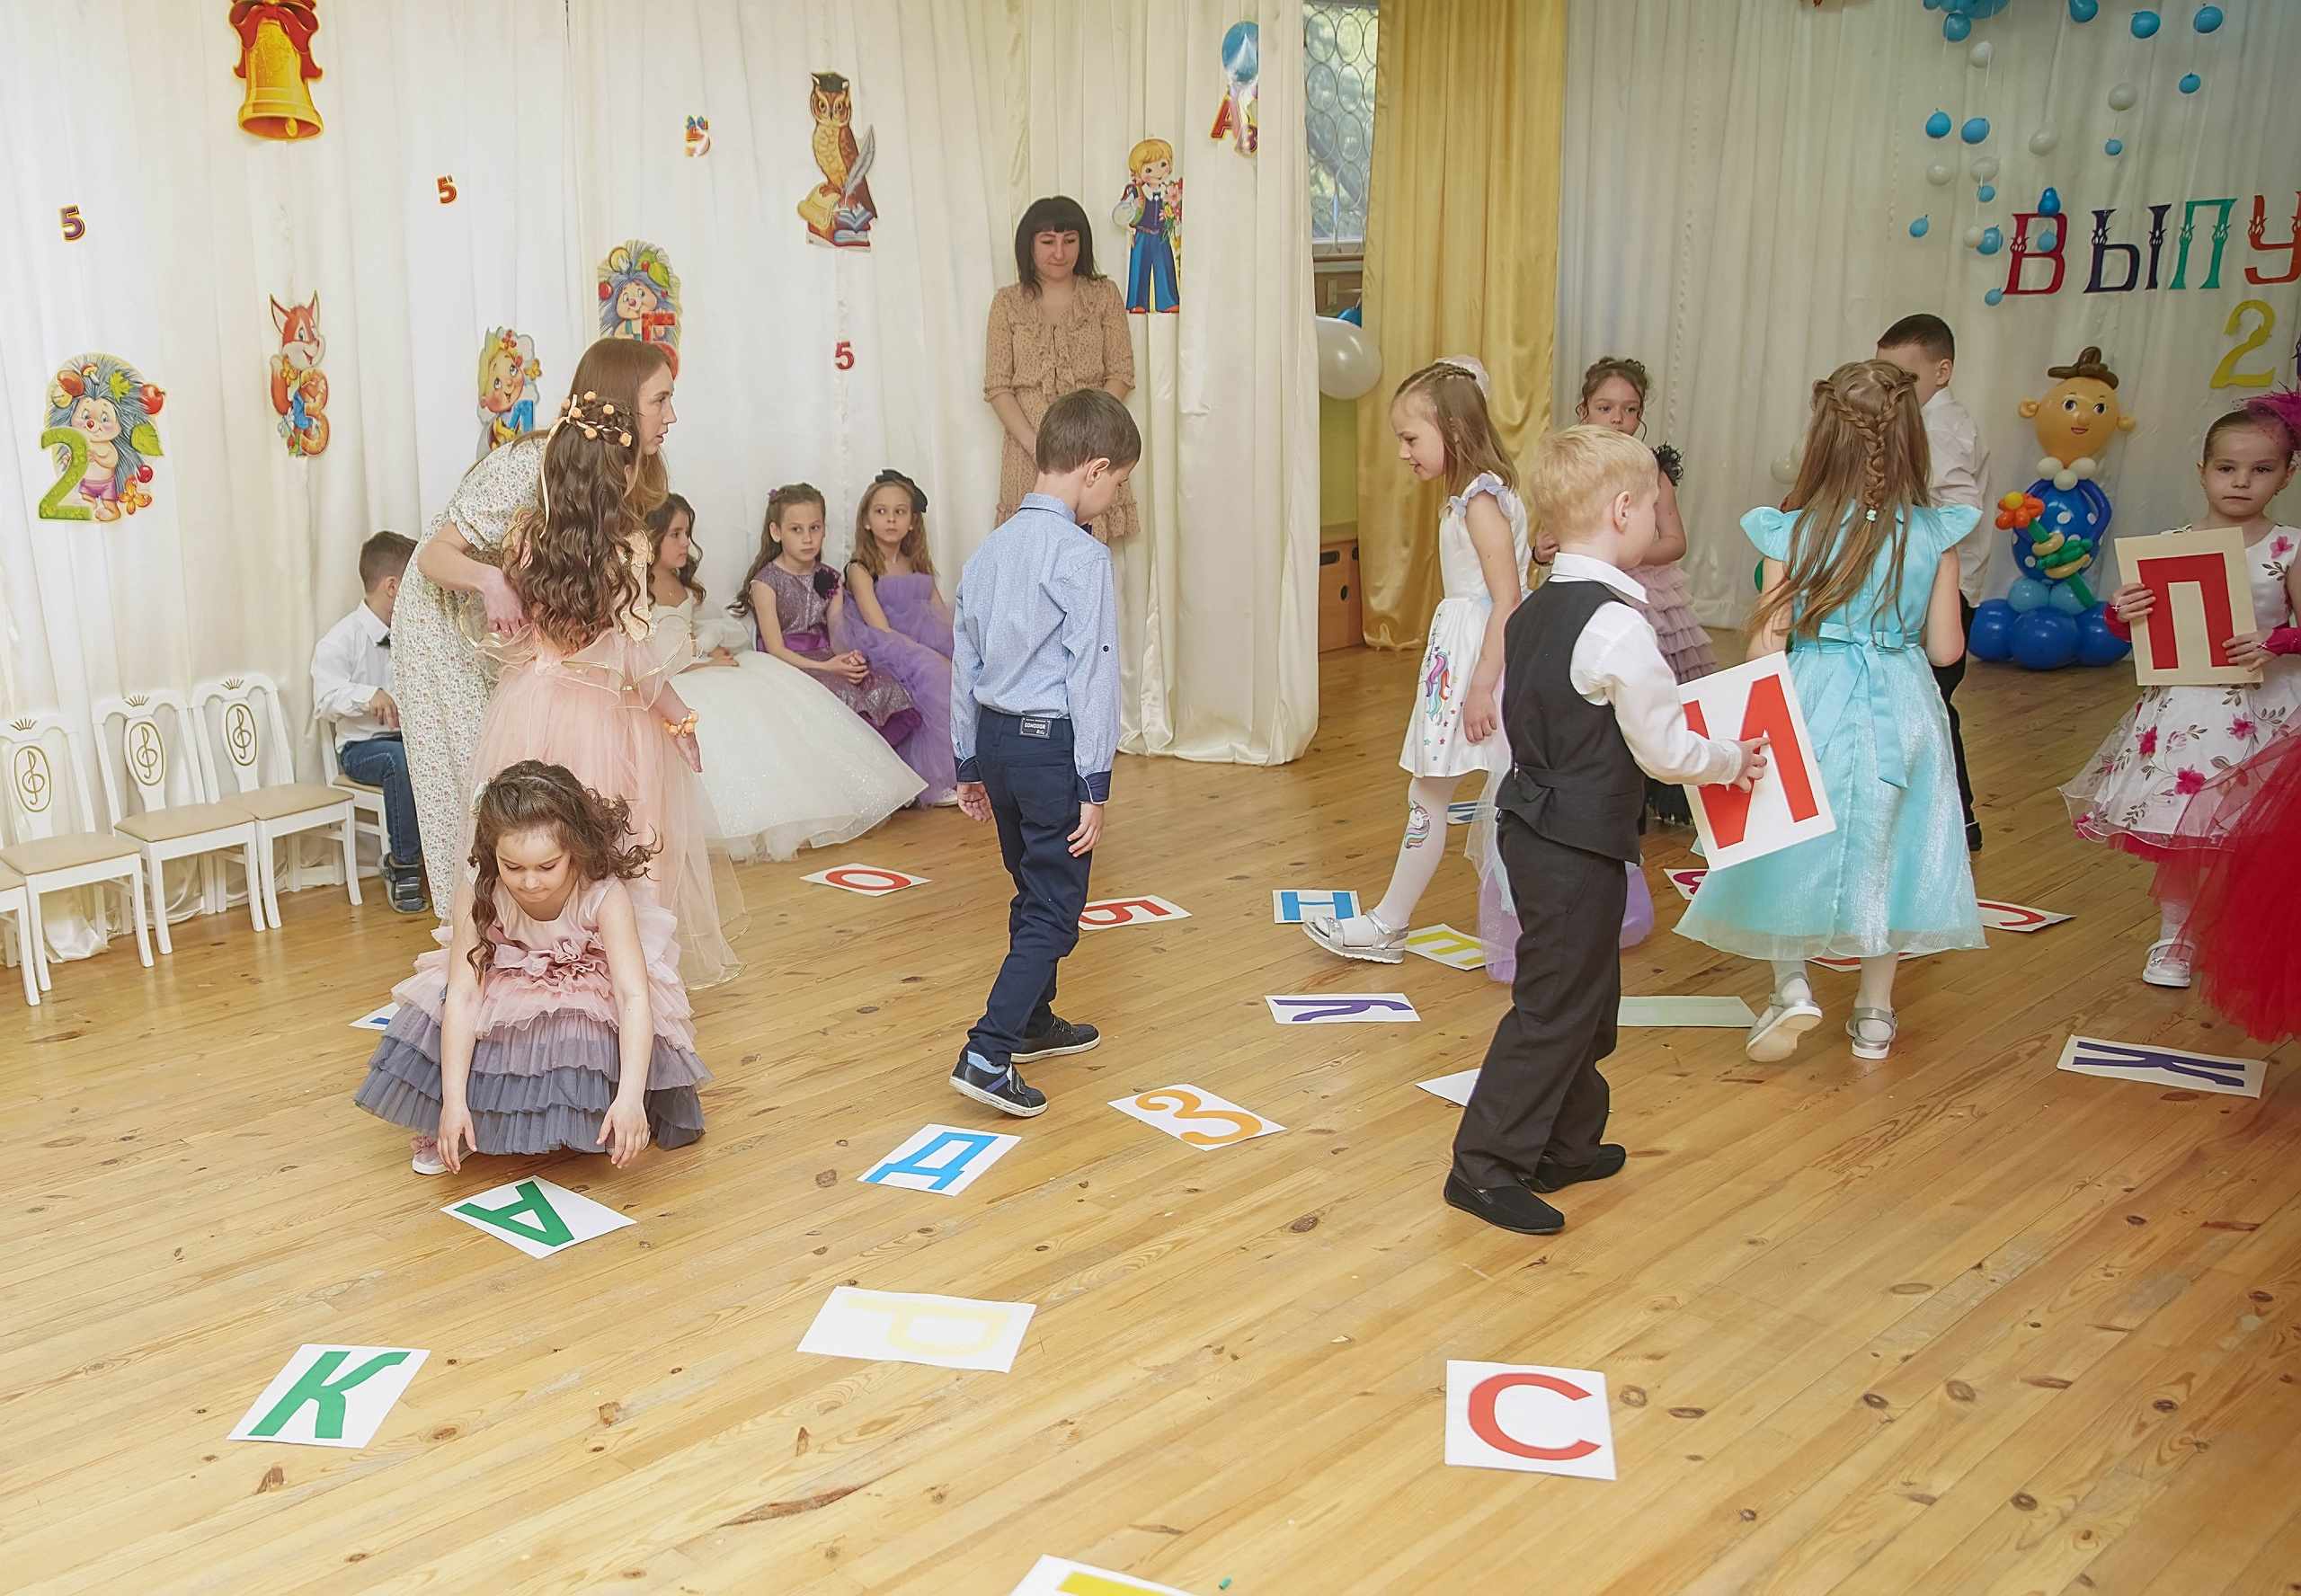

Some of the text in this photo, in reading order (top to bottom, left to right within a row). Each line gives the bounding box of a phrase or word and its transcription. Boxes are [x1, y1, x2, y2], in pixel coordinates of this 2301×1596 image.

[437, 175, 458, 204] 5
[60, 205, 85, 241] 5
[2003, 191, 2301, 295] ВЫПУ
[835, 341, 855, 369] 5
[39, 427, 91, 521] 2
[2137, 552, 2239, 670] П
[1683, 673, 1819, 849] И
[825, 869, 911, 890] О
[1077, 900, 1172, 926] Б
[866, 1131, 999, 1191] Д
[454, 1180, 574, 1246] А
[246, 1351, 411, 1439] К
[1468, 1372, 1602, 1461] С
